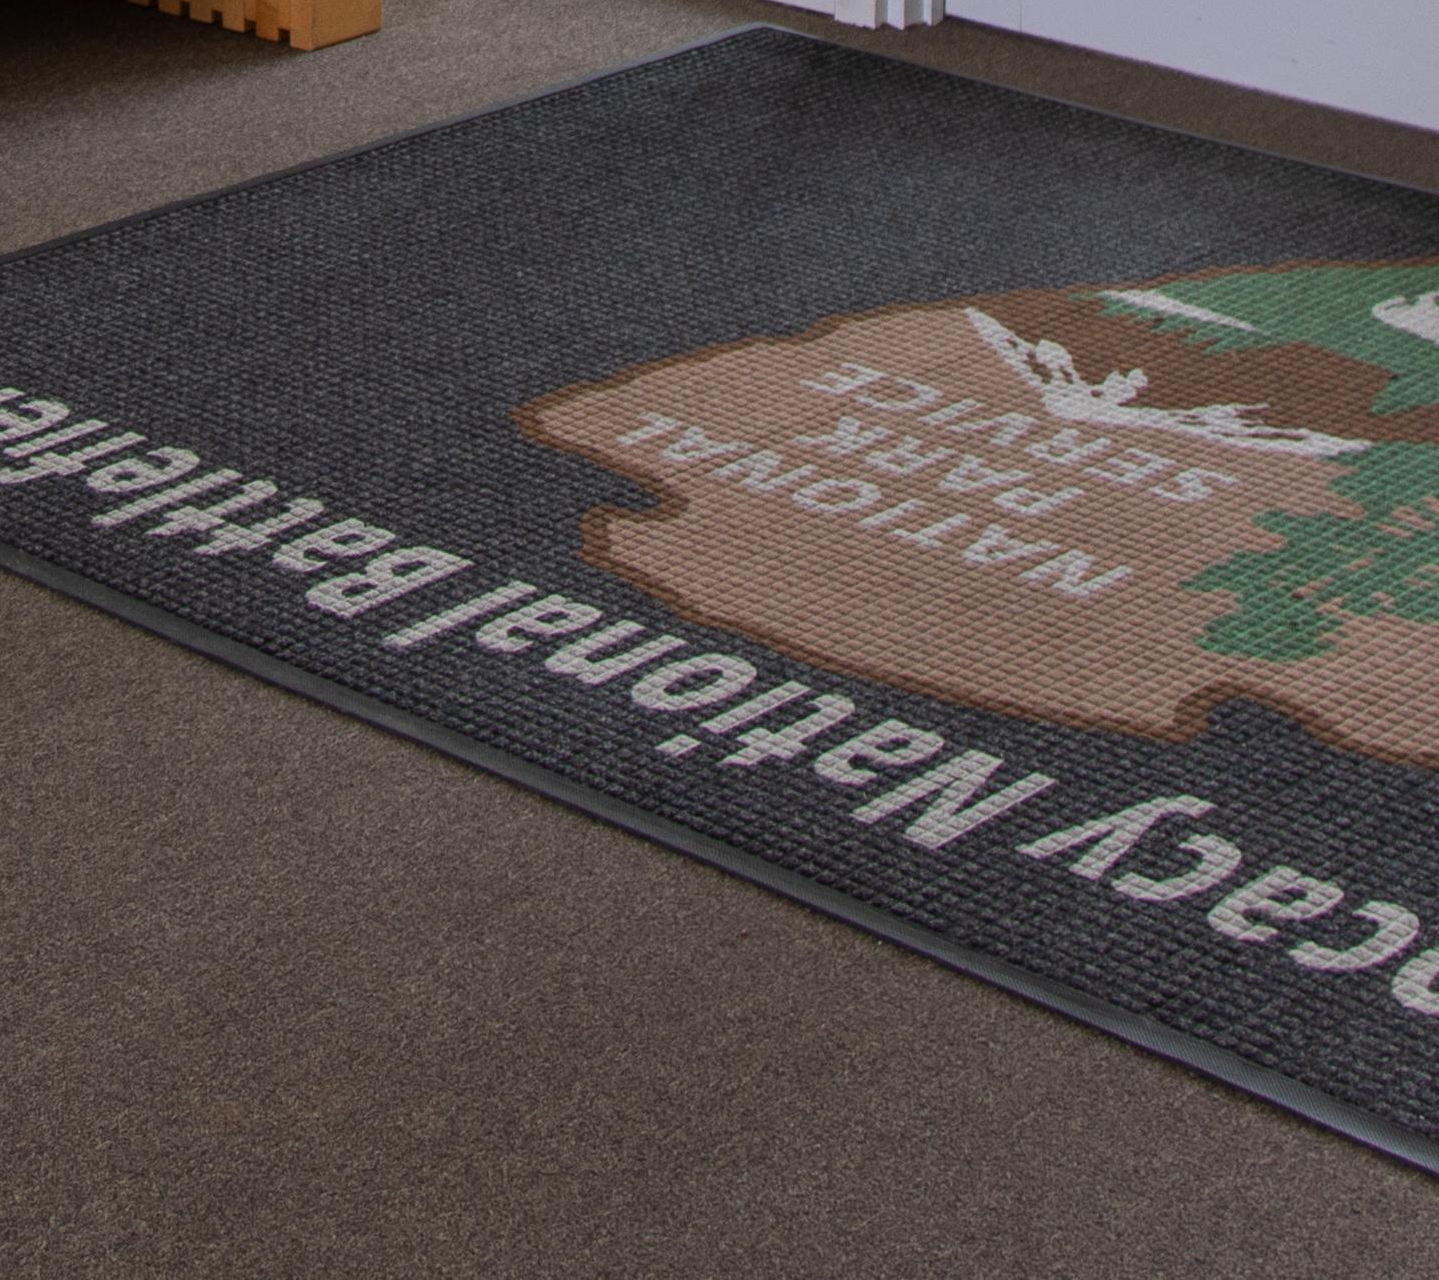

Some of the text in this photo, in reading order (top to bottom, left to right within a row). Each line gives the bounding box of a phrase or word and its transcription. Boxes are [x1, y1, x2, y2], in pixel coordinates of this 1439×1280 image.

[613, 407, 1135, 596] NATIONAL
[816, 354, 1238, 510] SERVICE
[828, 415, 1076, 522] PARK
[383, 573, 1051, 854] National
